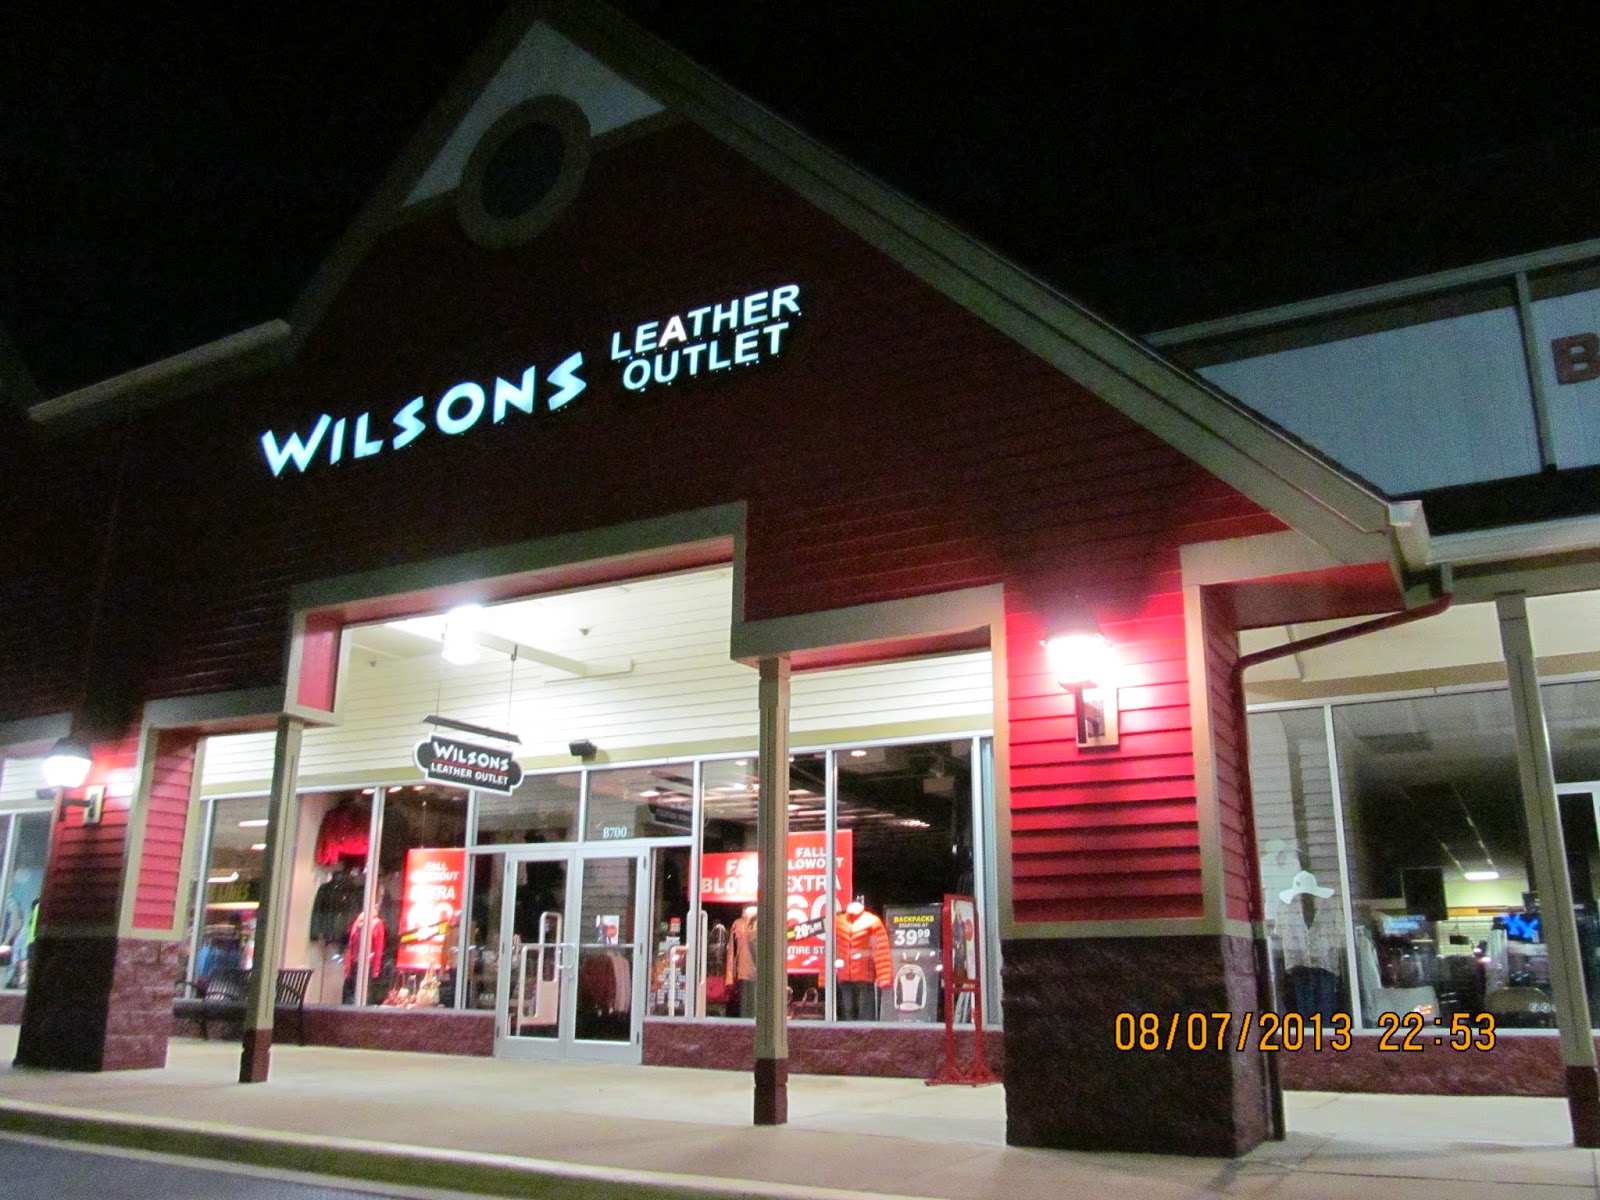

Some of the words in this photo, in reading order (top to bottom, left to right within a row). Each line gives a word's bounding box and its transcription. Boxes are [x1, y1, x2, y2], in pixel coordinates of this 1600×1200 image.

[611, 284, 801, 361] LEATHER
[623, 322, 790, 391] OUTLET
[260, 351, 587, 477] WILSONS
[433, 741, 510, 771] WILSONS
[431, 762, 473, 778] LEATHER
[475, 771, 509, 786] OUTLET
[787, 857, 844, 870] LOWOT
[796, 847, 827, 858] FALL
[894, 915, 935, 923] BACKPACKS
[787, 946, 811, 954] TIRE
